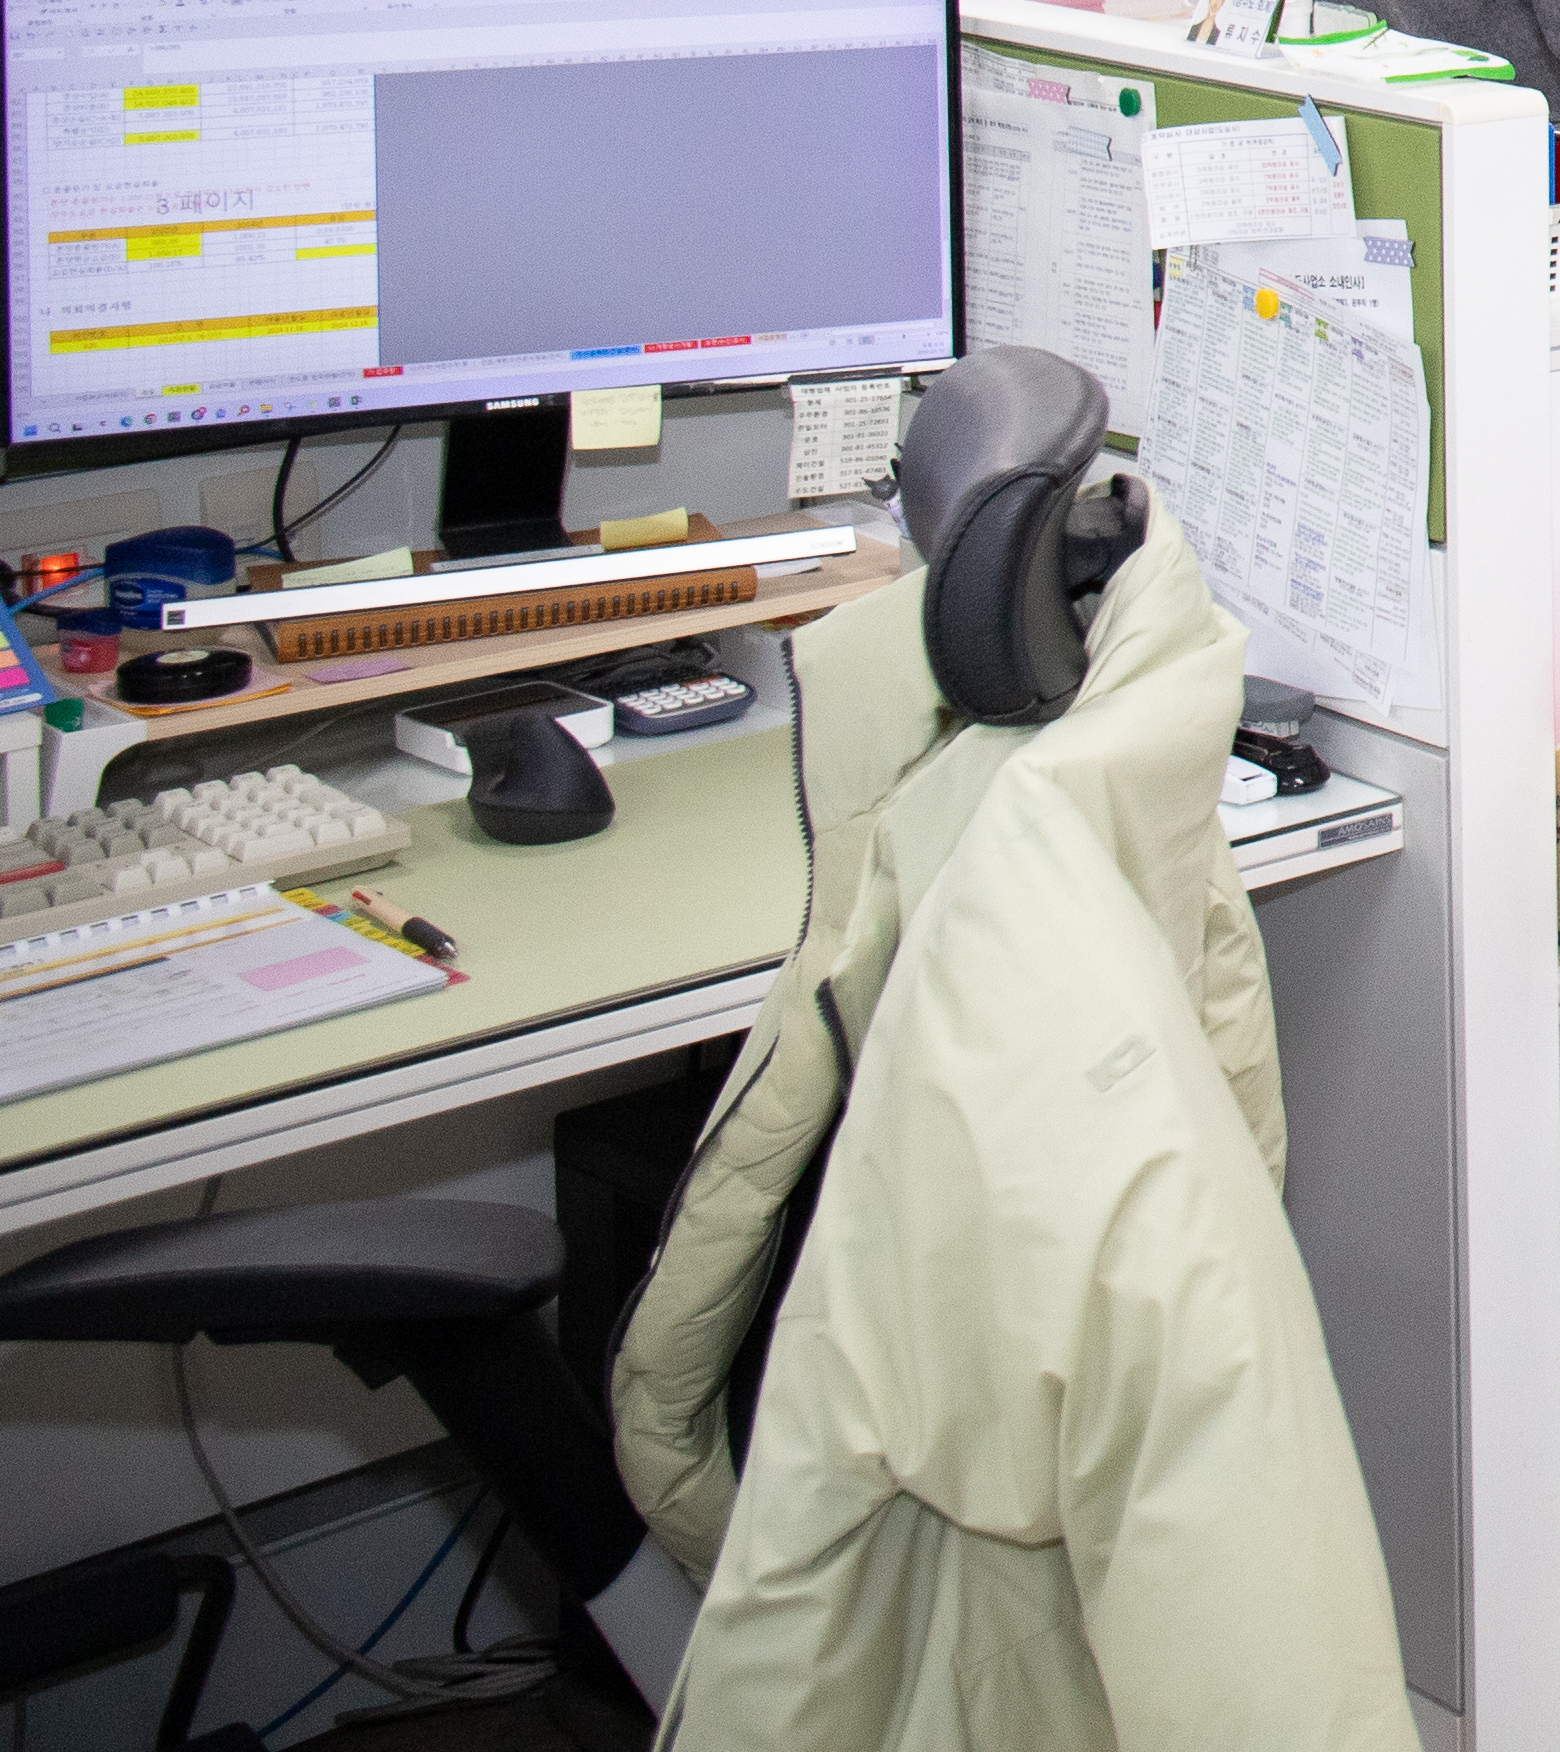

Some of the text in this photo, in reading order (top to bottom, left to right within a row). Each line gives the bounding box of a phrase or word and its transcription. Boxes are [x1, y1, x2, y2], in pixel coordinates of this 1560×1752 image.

[156, 199, 169, 215] 3
[179, 188, 254, 214] 페이지
[486, 398, 540, 411] SAMSUNG
